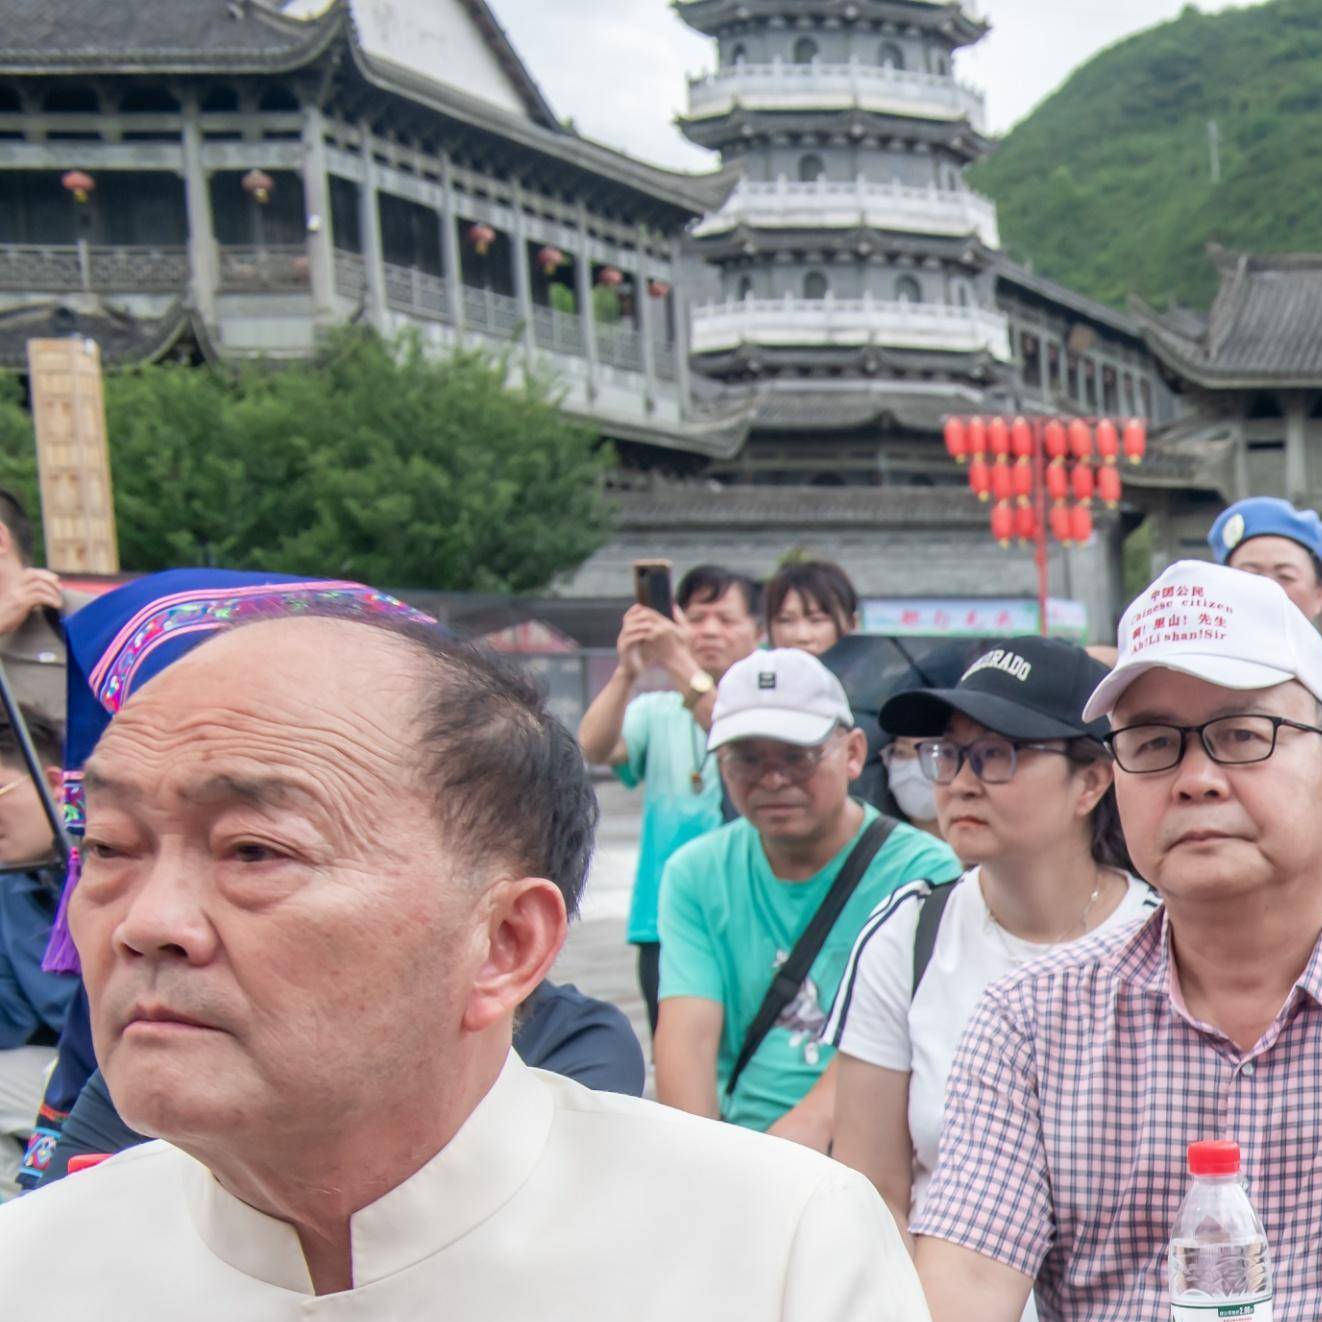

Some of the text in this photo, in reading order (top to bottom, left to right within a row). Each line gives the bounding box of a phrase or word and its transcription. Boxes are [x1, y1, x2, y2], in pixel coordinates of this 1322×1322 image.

[1151, 585, 1205, 601] 中国公民
[1182, 600, 1233, 614] citizen
[1198, 613, 1227, 627] 先生
